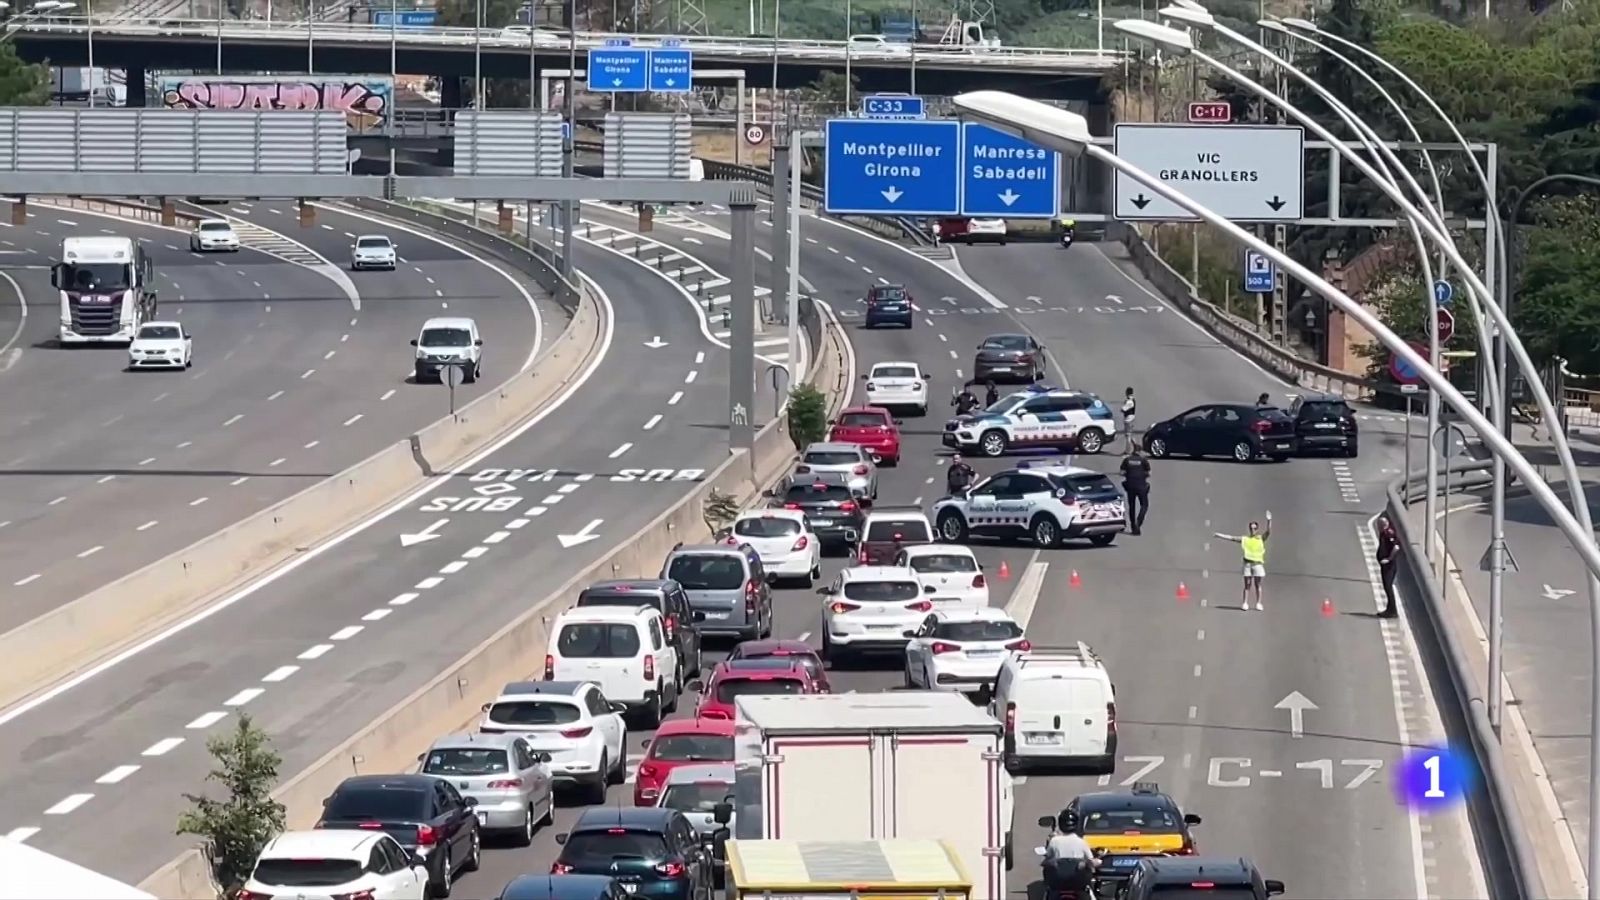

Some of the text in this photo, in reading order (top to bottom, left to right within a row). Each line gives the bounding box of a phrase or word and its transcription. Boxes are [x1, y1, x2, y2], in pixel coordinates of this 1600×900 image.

[595, 56, 640, 64] Montpellier
[869, 100, 903, 112] C-33
[1195, 106, 1224, 117] C-17
[843, 143, 942, 159] Montpellier
[973, 145, 1046, 159] Manresa
[1197, 153, 1221, 164] VIC
[864, 163, 921, 177] Girona
[973, 165, 1046, 180] Sabadell
[1159, 170, 1258, 182] GRANOLLERS
[609, 469, 705, 482] BUS
[419, 497, 524, 512] BUS
[1207, 757, 1384, 789] C-17
